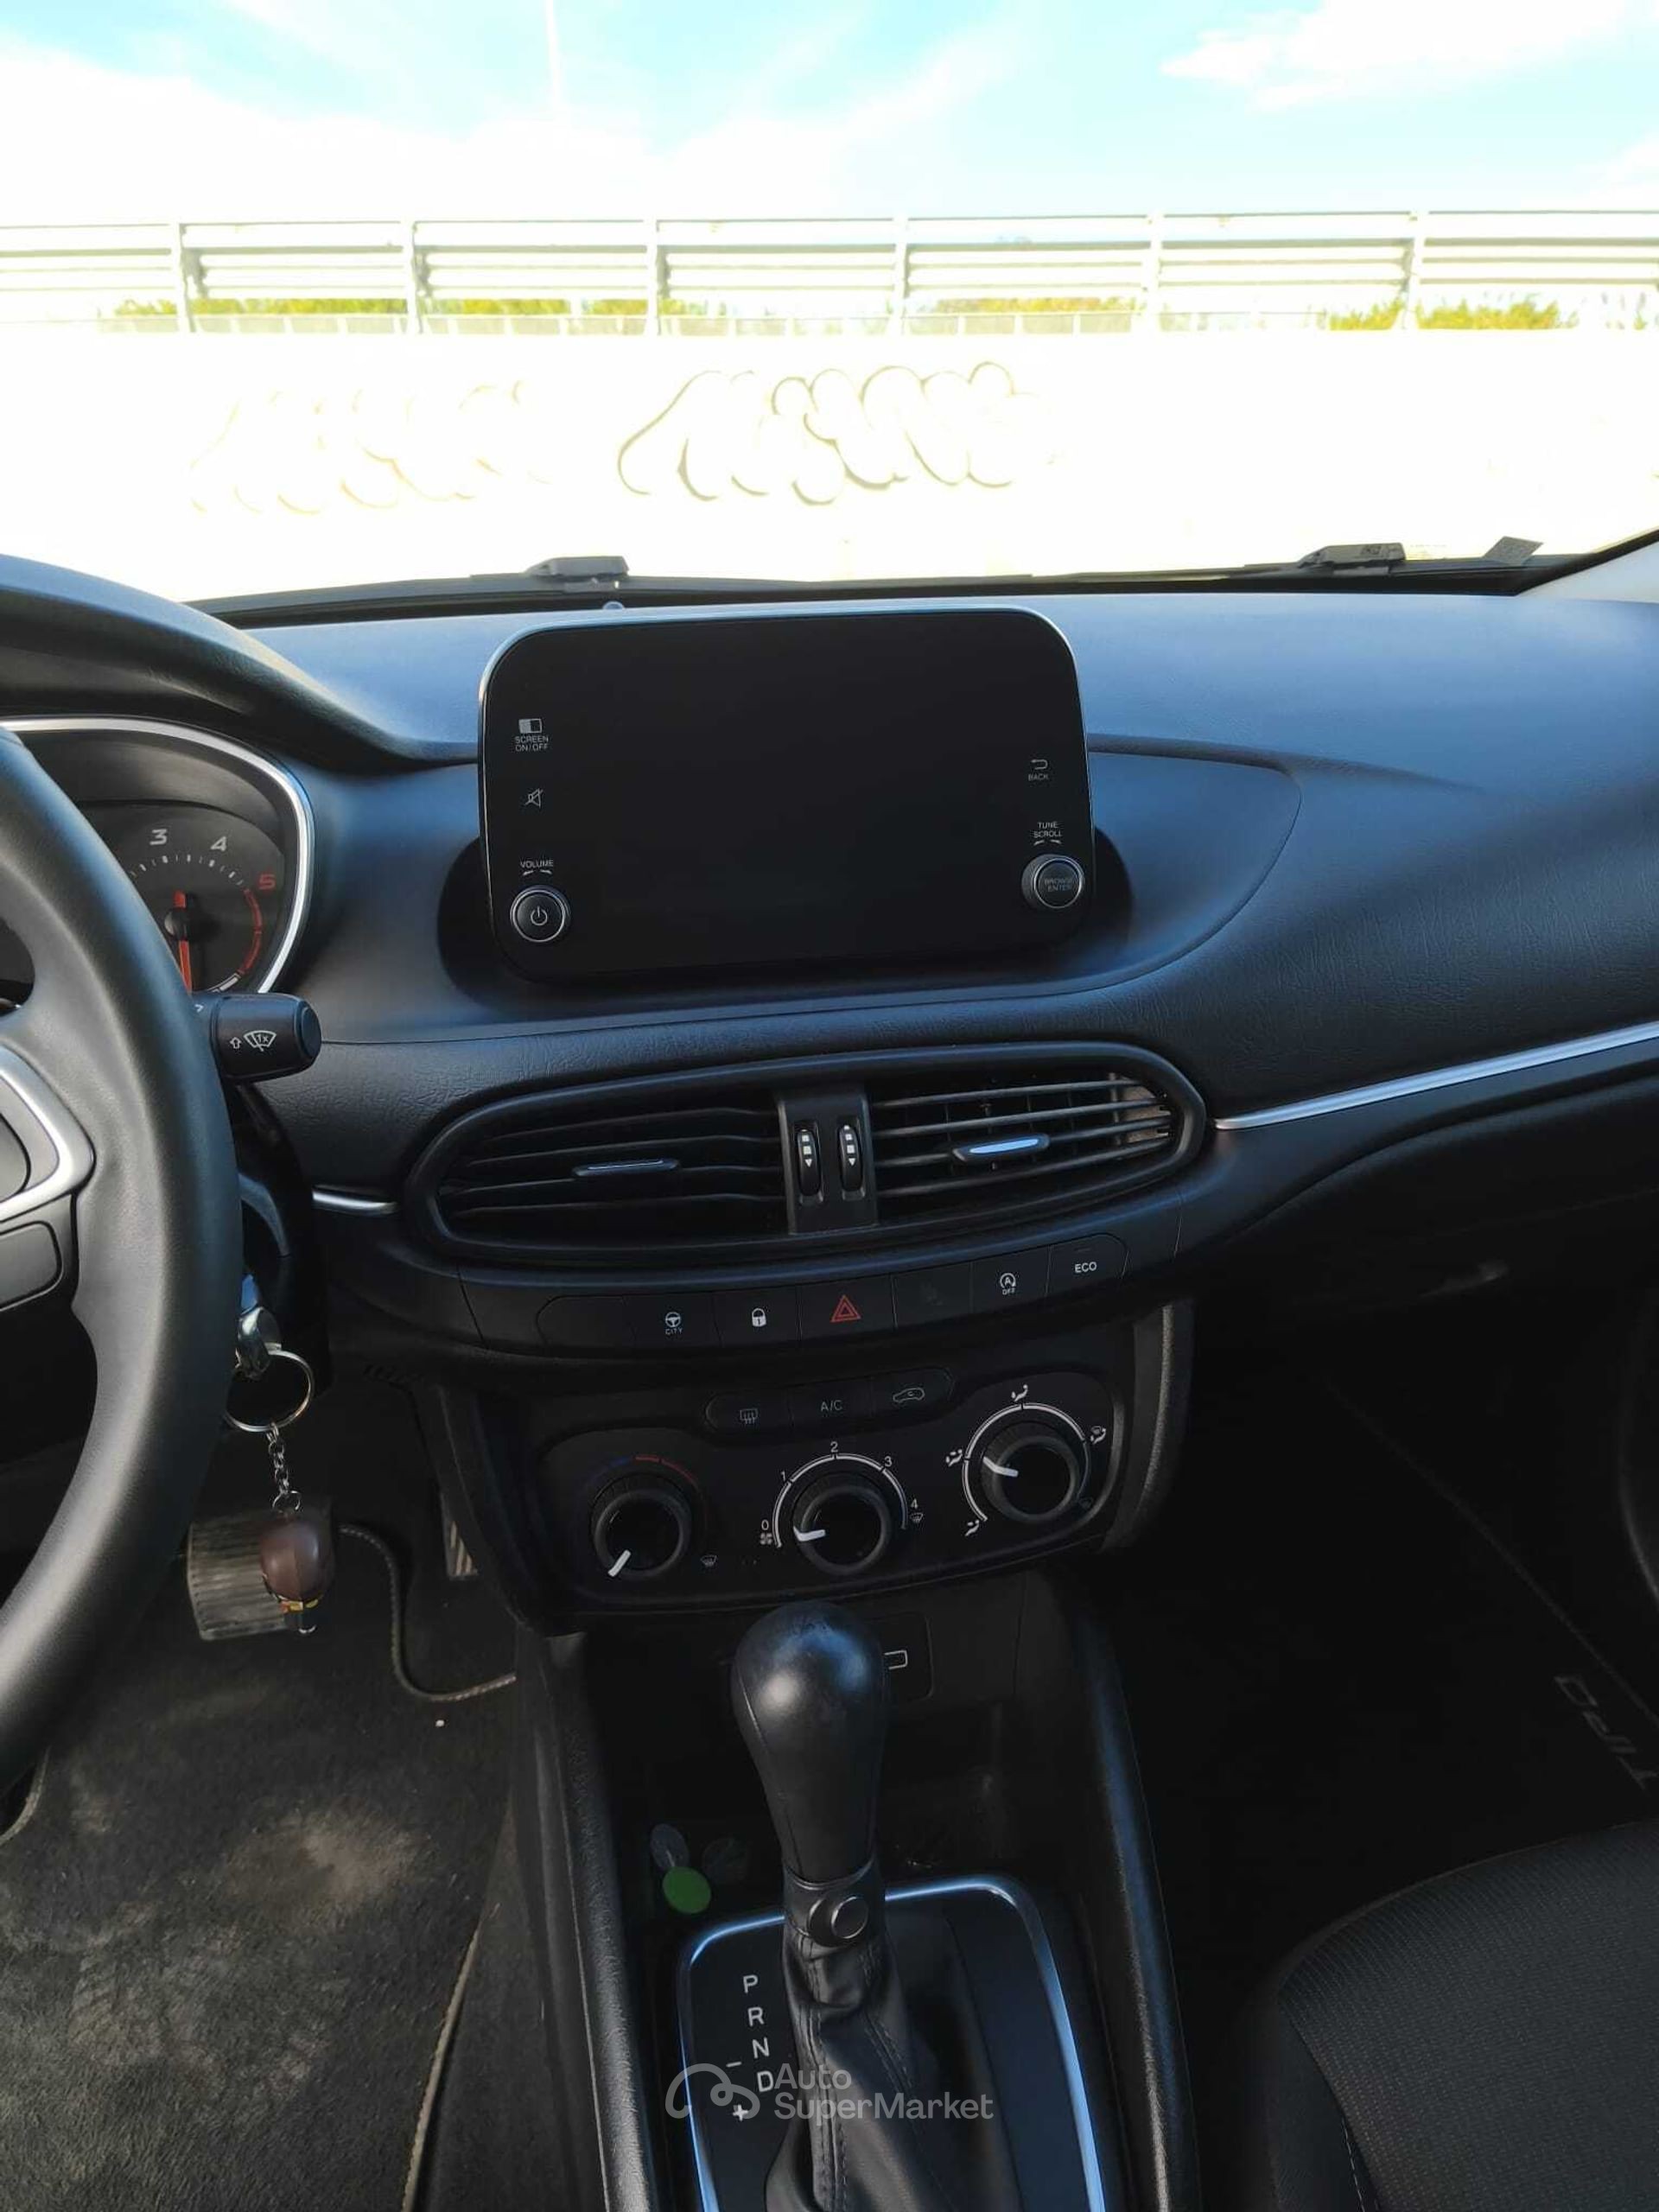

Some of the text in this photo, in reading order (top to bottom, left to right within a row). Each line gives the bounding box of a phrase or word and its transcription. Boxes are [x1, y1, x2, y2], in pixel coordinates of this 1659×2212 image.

[515, 735, 549, 744] SCREEN
[515, 743, 548, 752] ON/OFF
[1028, 773, 1049, 782] BACK
[149, 828, 168, 846] 3
[1033, 830, 1062, 838] SCROLL
[210, 836, 227, 852] 4
[520, 860, 554, 868] VOLUME
[258, 873, 276, 890] 5
[1074, 1262, 1097, 1274] ECO
[820, 1399, 843, 1412] A/C
[830, 1441, 838, 1452] 2
[885, 1456, 893, 1467] 3
[781, 1471, 787, 1481] 1
[910, 1498, 918, 1510] 4
[743, 1974, 759, 1993] P
[747, 2006, 764, 2027] R
[752, 2037, 770, 2059] N
[757, 2070, 773, 2092] D
